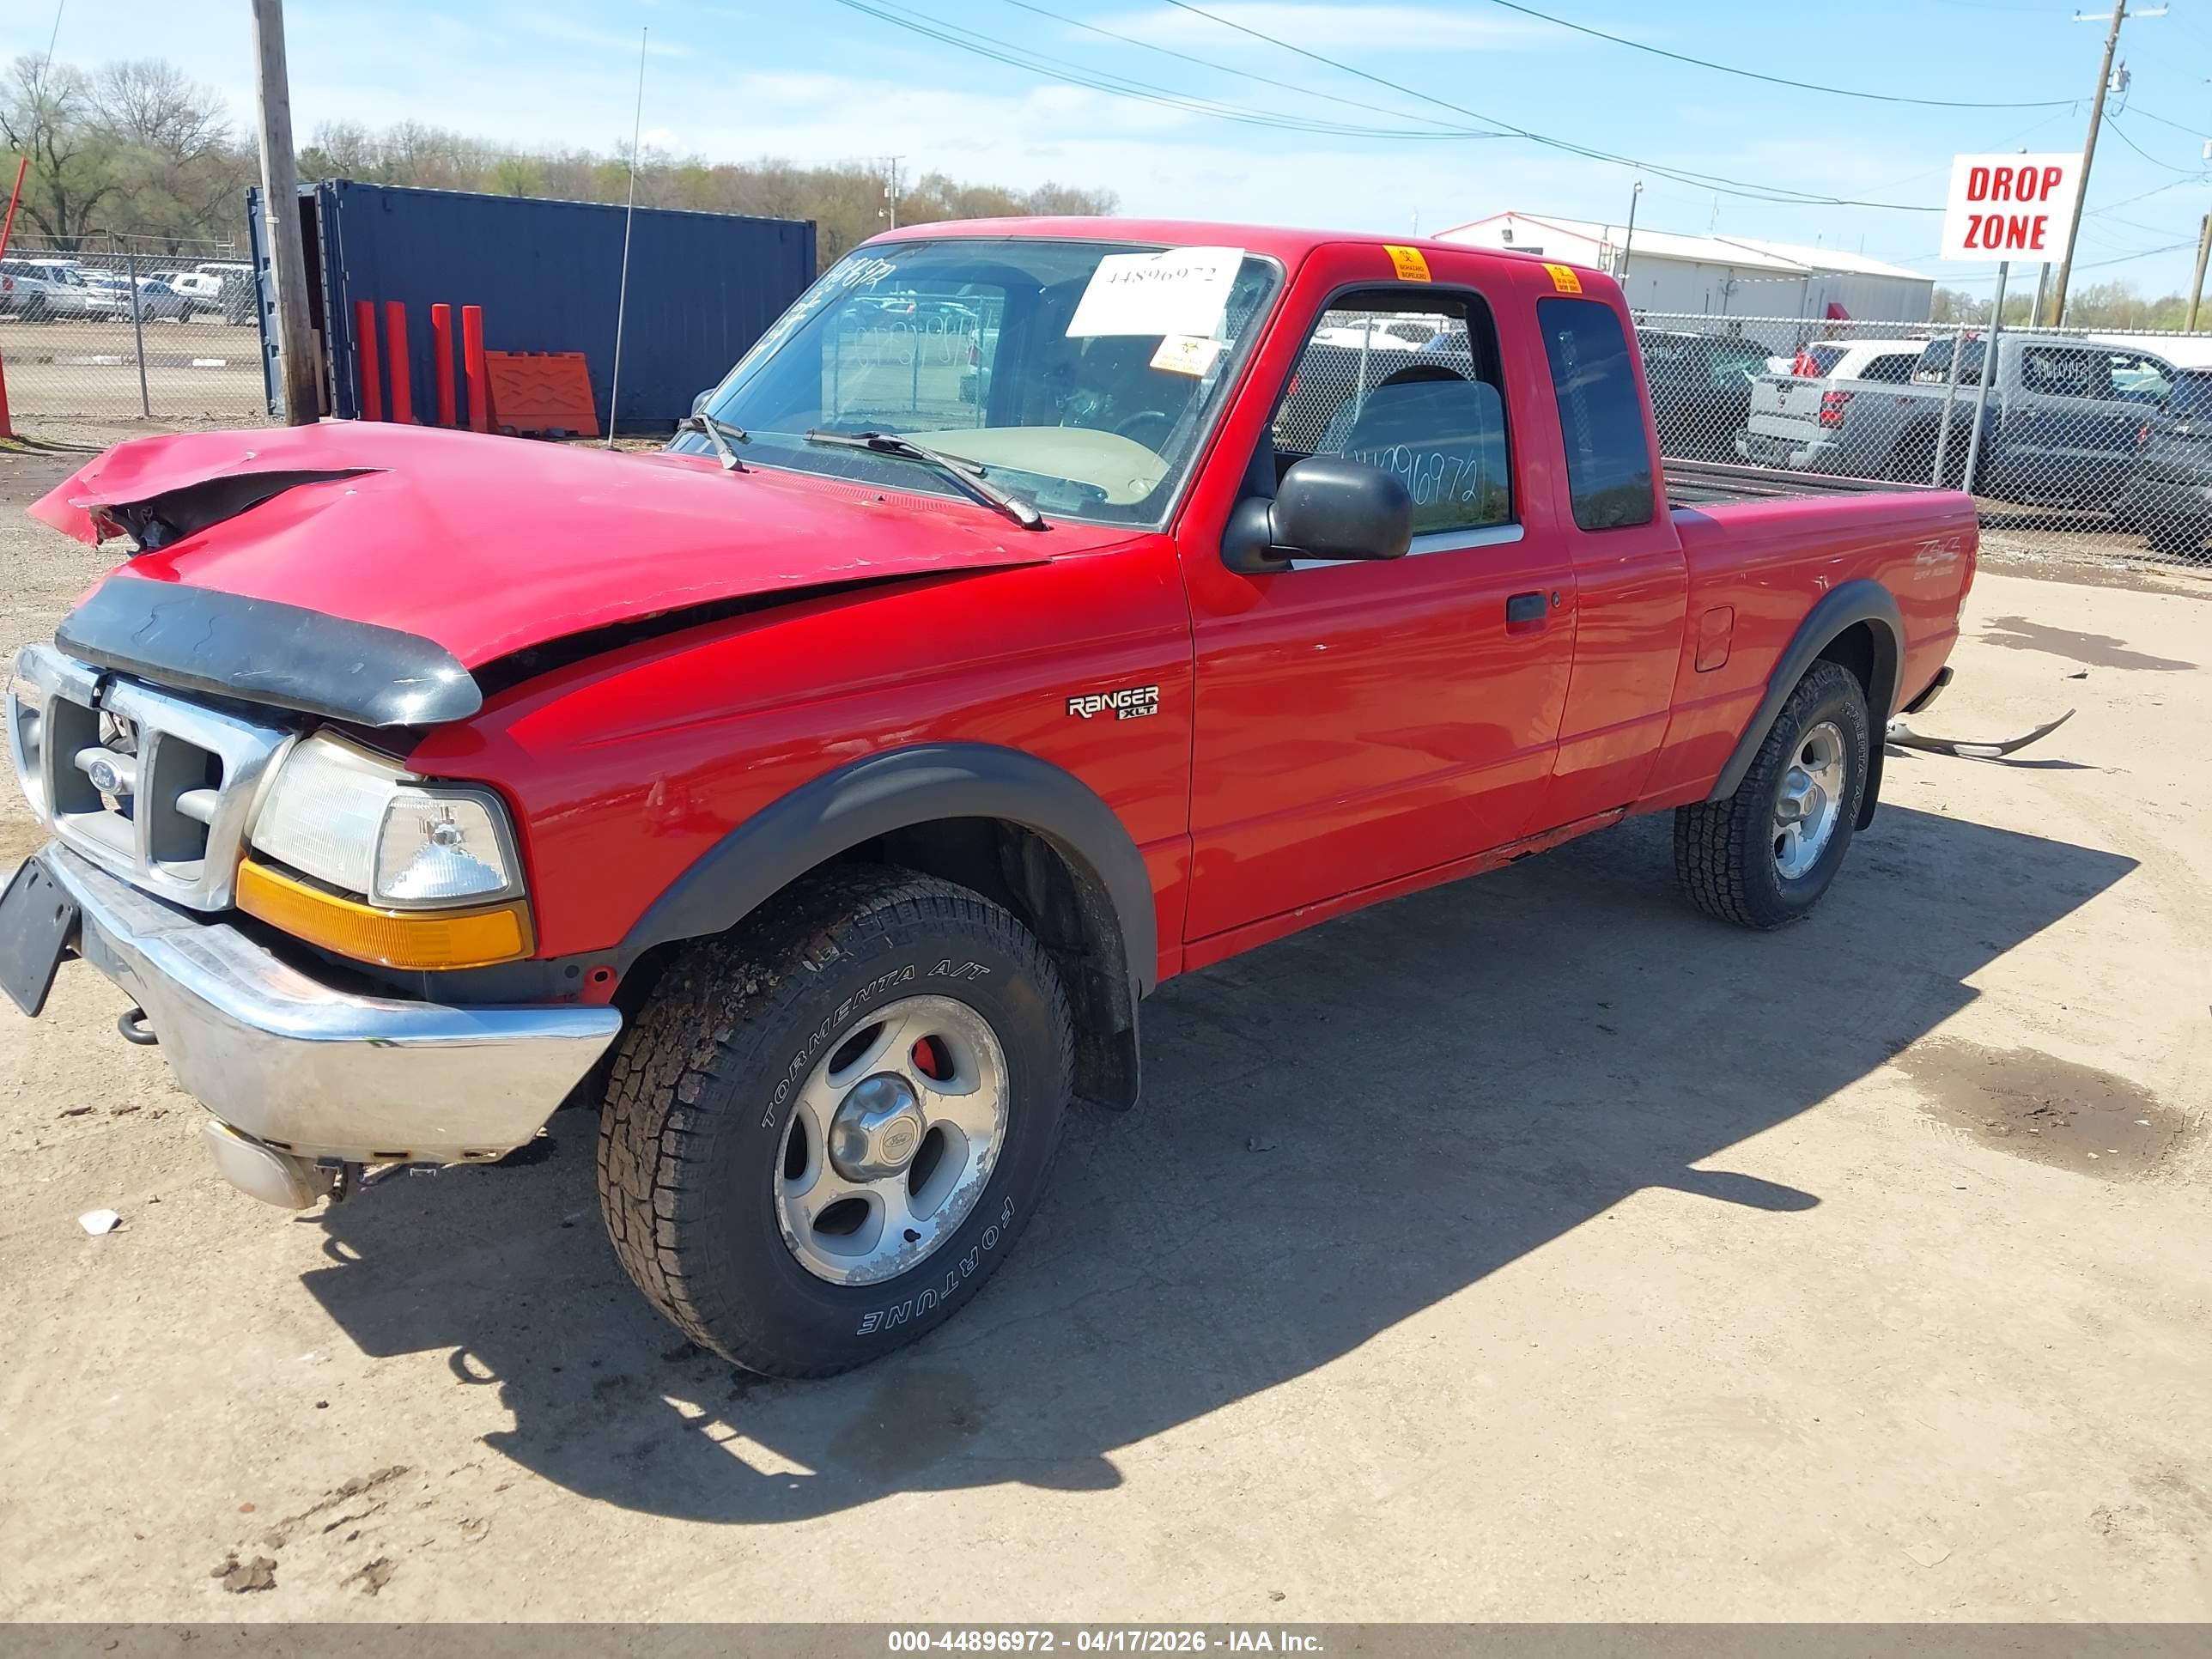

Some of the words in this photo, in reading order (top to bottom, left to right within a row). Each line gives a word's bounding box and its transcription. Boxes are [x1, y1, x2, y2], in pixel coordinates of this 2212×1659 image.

[1966, 167, 2063, 202] DROP
[1963, 214, 2050, 250] ZONE
[1341, 445, 1478, 505] 96972
[1068, 686, 1159, 719] RANGER
[1121, 705, 1156, 719] XLT
[91, 763, 113, 787] Ford
[762, 964, 915, 1129] TORMENTA
[927, 959, 991, 981] A/T
[857, 1196, 1015, 1335] FORTUNE
